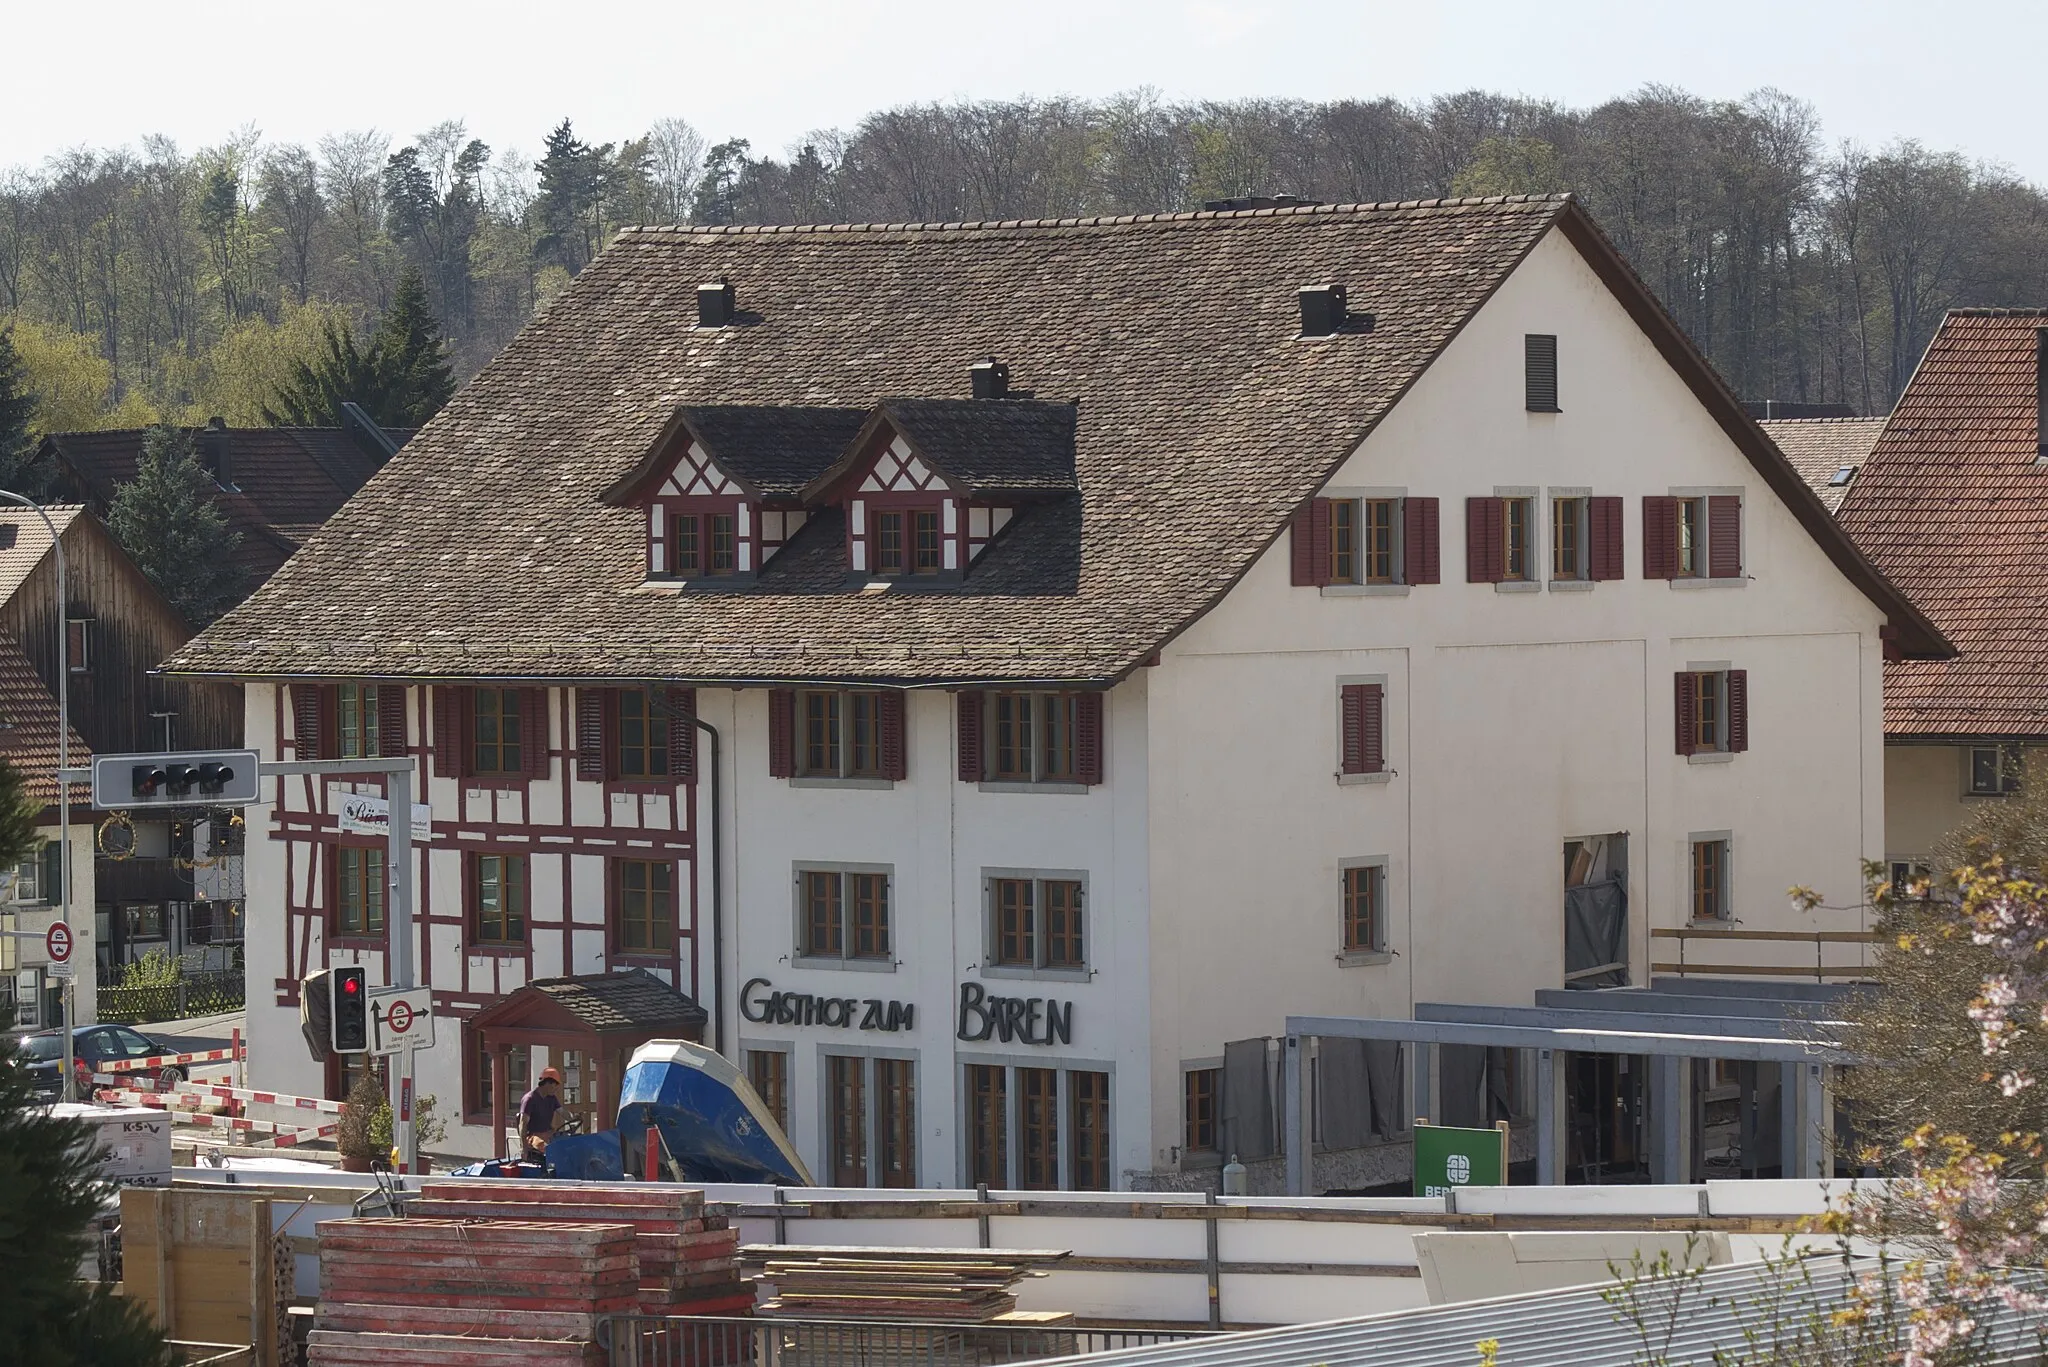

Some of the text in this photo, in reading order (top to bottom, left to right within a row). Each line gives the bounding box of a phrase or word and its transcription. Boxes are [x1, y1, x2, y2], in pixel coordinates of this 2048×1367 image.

[740, 978, 914, 1032] GASTHOF ZUM
[957, 982, 1072, 1045] BÄREN
